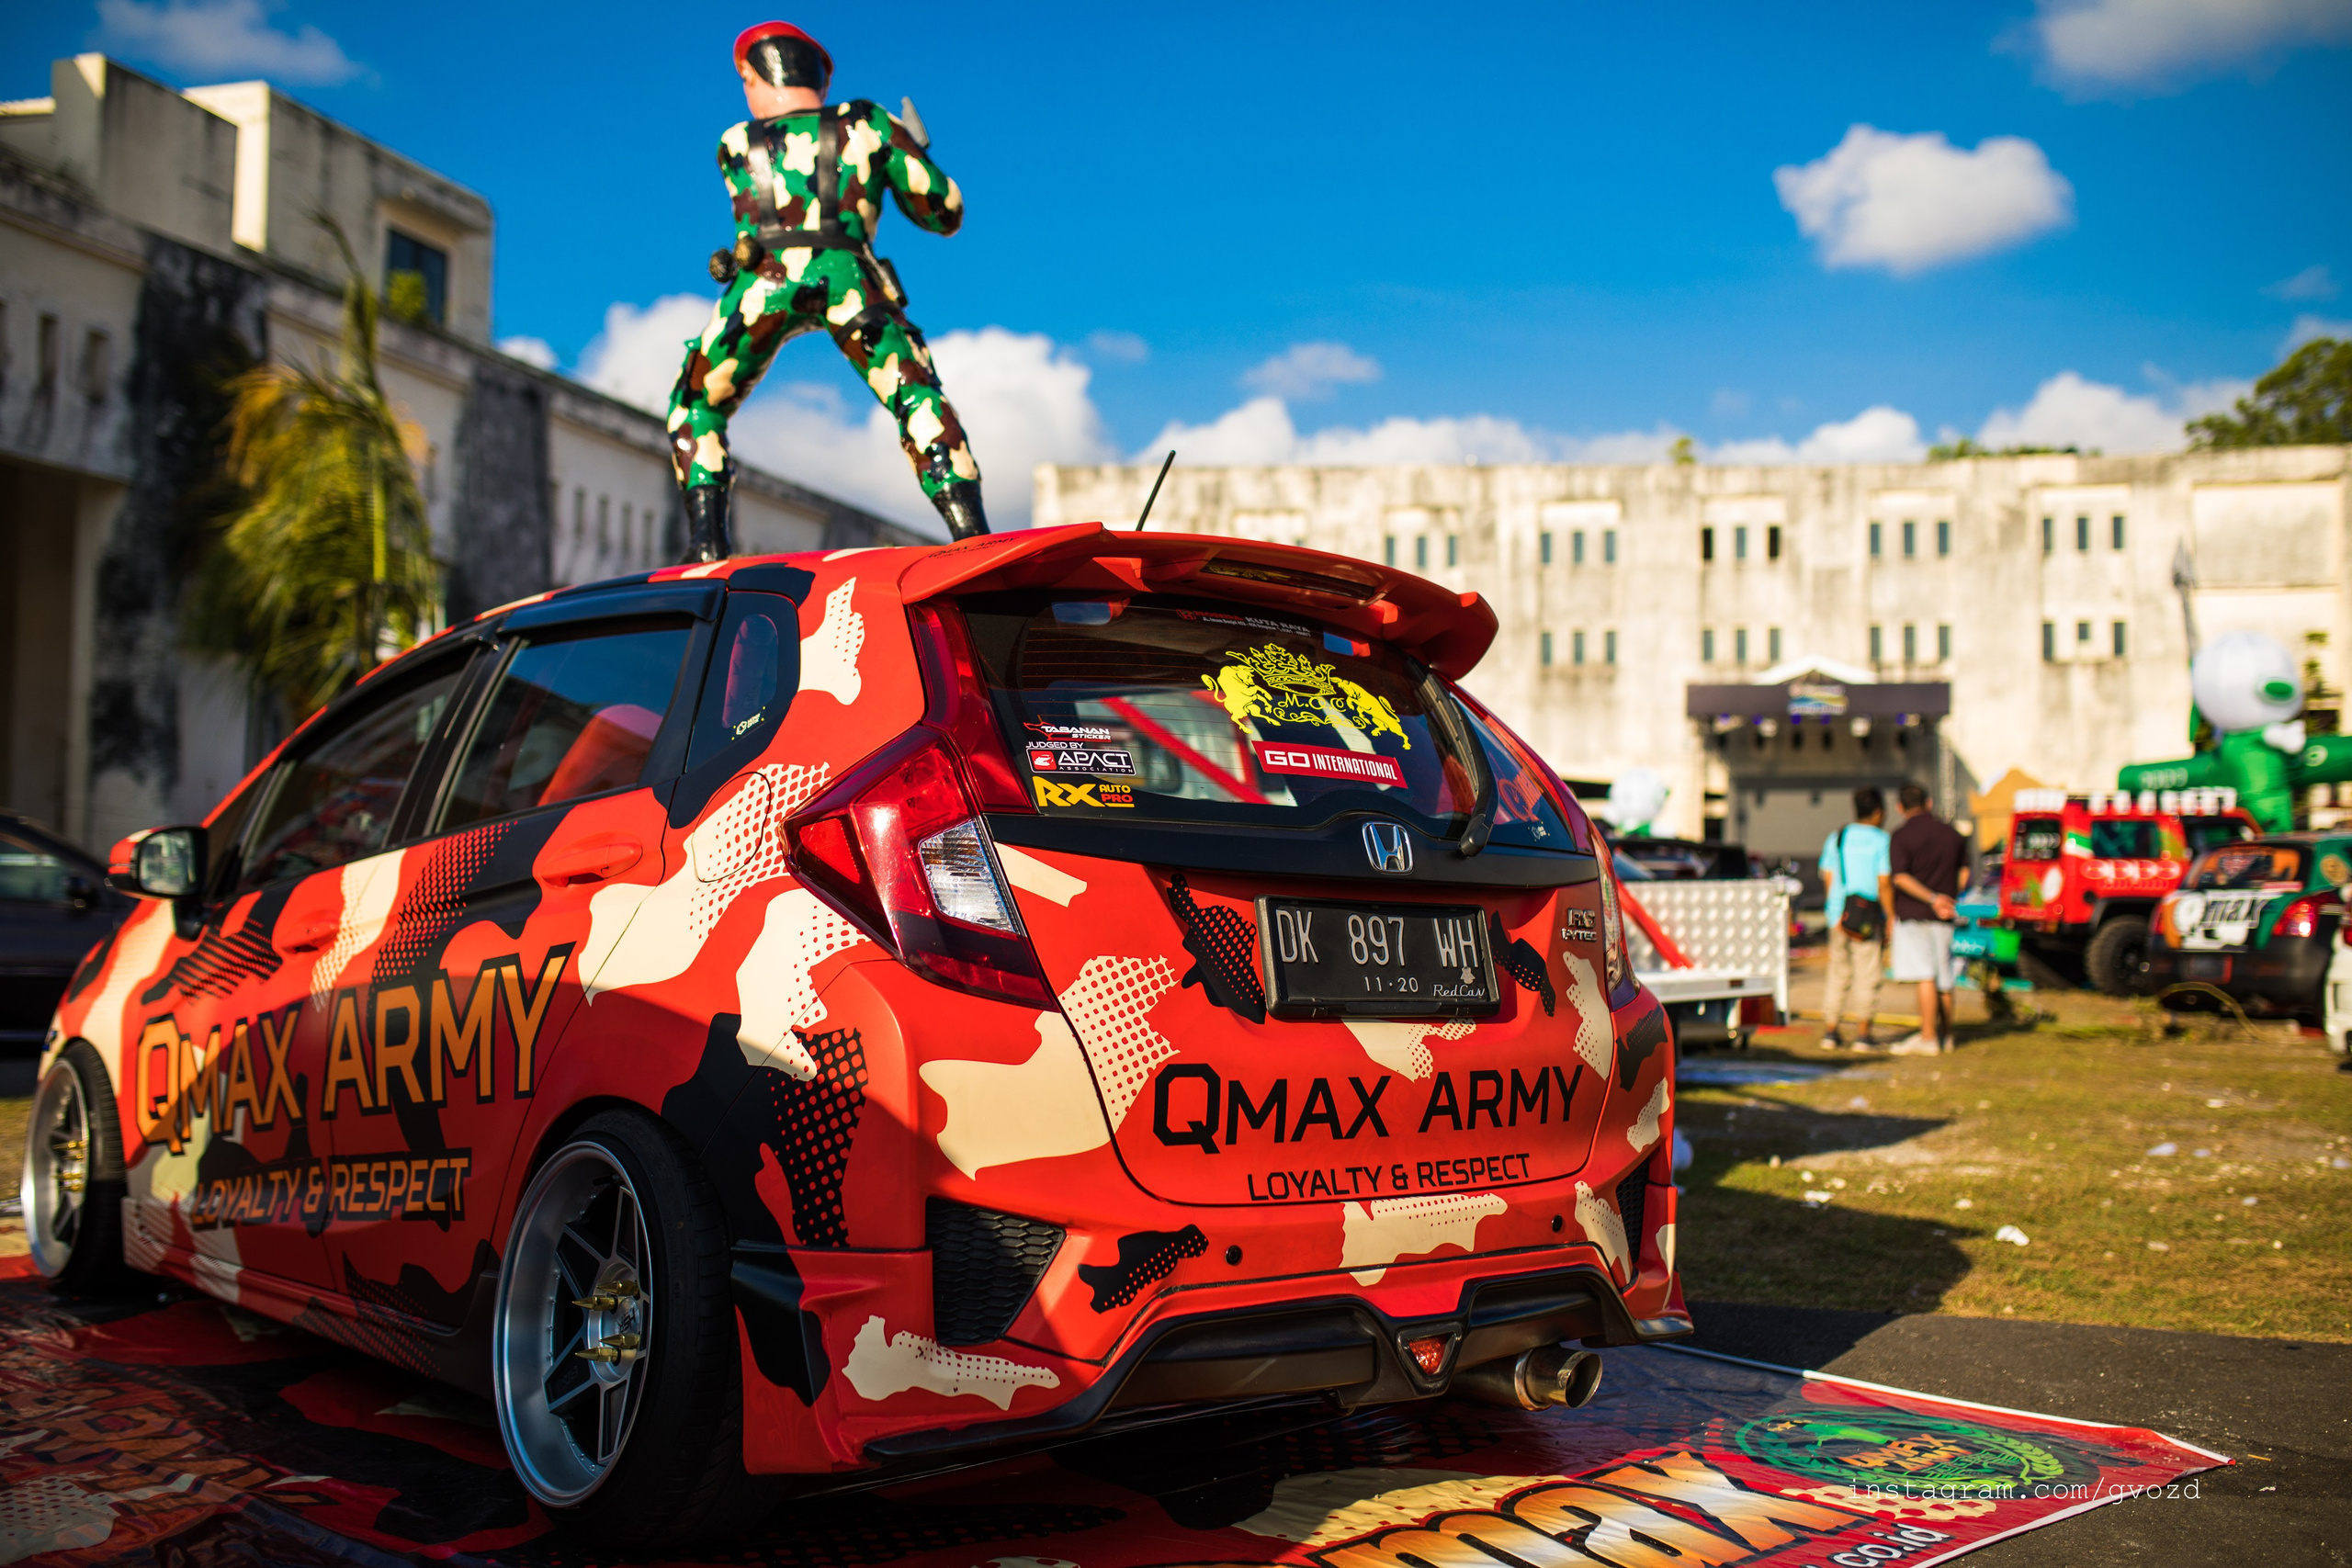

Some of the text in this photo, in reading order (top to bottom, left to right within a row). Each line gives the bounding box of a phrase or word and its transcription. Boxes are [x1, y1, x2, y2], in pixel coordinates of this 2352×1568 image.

[1193, 611, 1310, 633] HONDA KUTA RAYA
[1040, 726, 1110, 735] TABANAN
[1057, 750, 1132, 769] APACT
[1264, 750, 1398, 781] GO INTERNATIONAL
[1032, 775, 1106, 807] RX
[1099, 784, 1131, 794] AUTO
[1101, 793, 1134, 803] PRO
[1567, 908, 1596, 928] RS
[1275, 908, 1479, 968] DK 897 WH
[135, 944, 575, 1156] QMAX ARMY
[1152, 1063, 1584, 1155] QMAX ARMY
[190, 1154, 470, 1226] LOYALTY & RESPECT
[1247, 1152, 1531, 1201] LOYALTY & RESPECT
